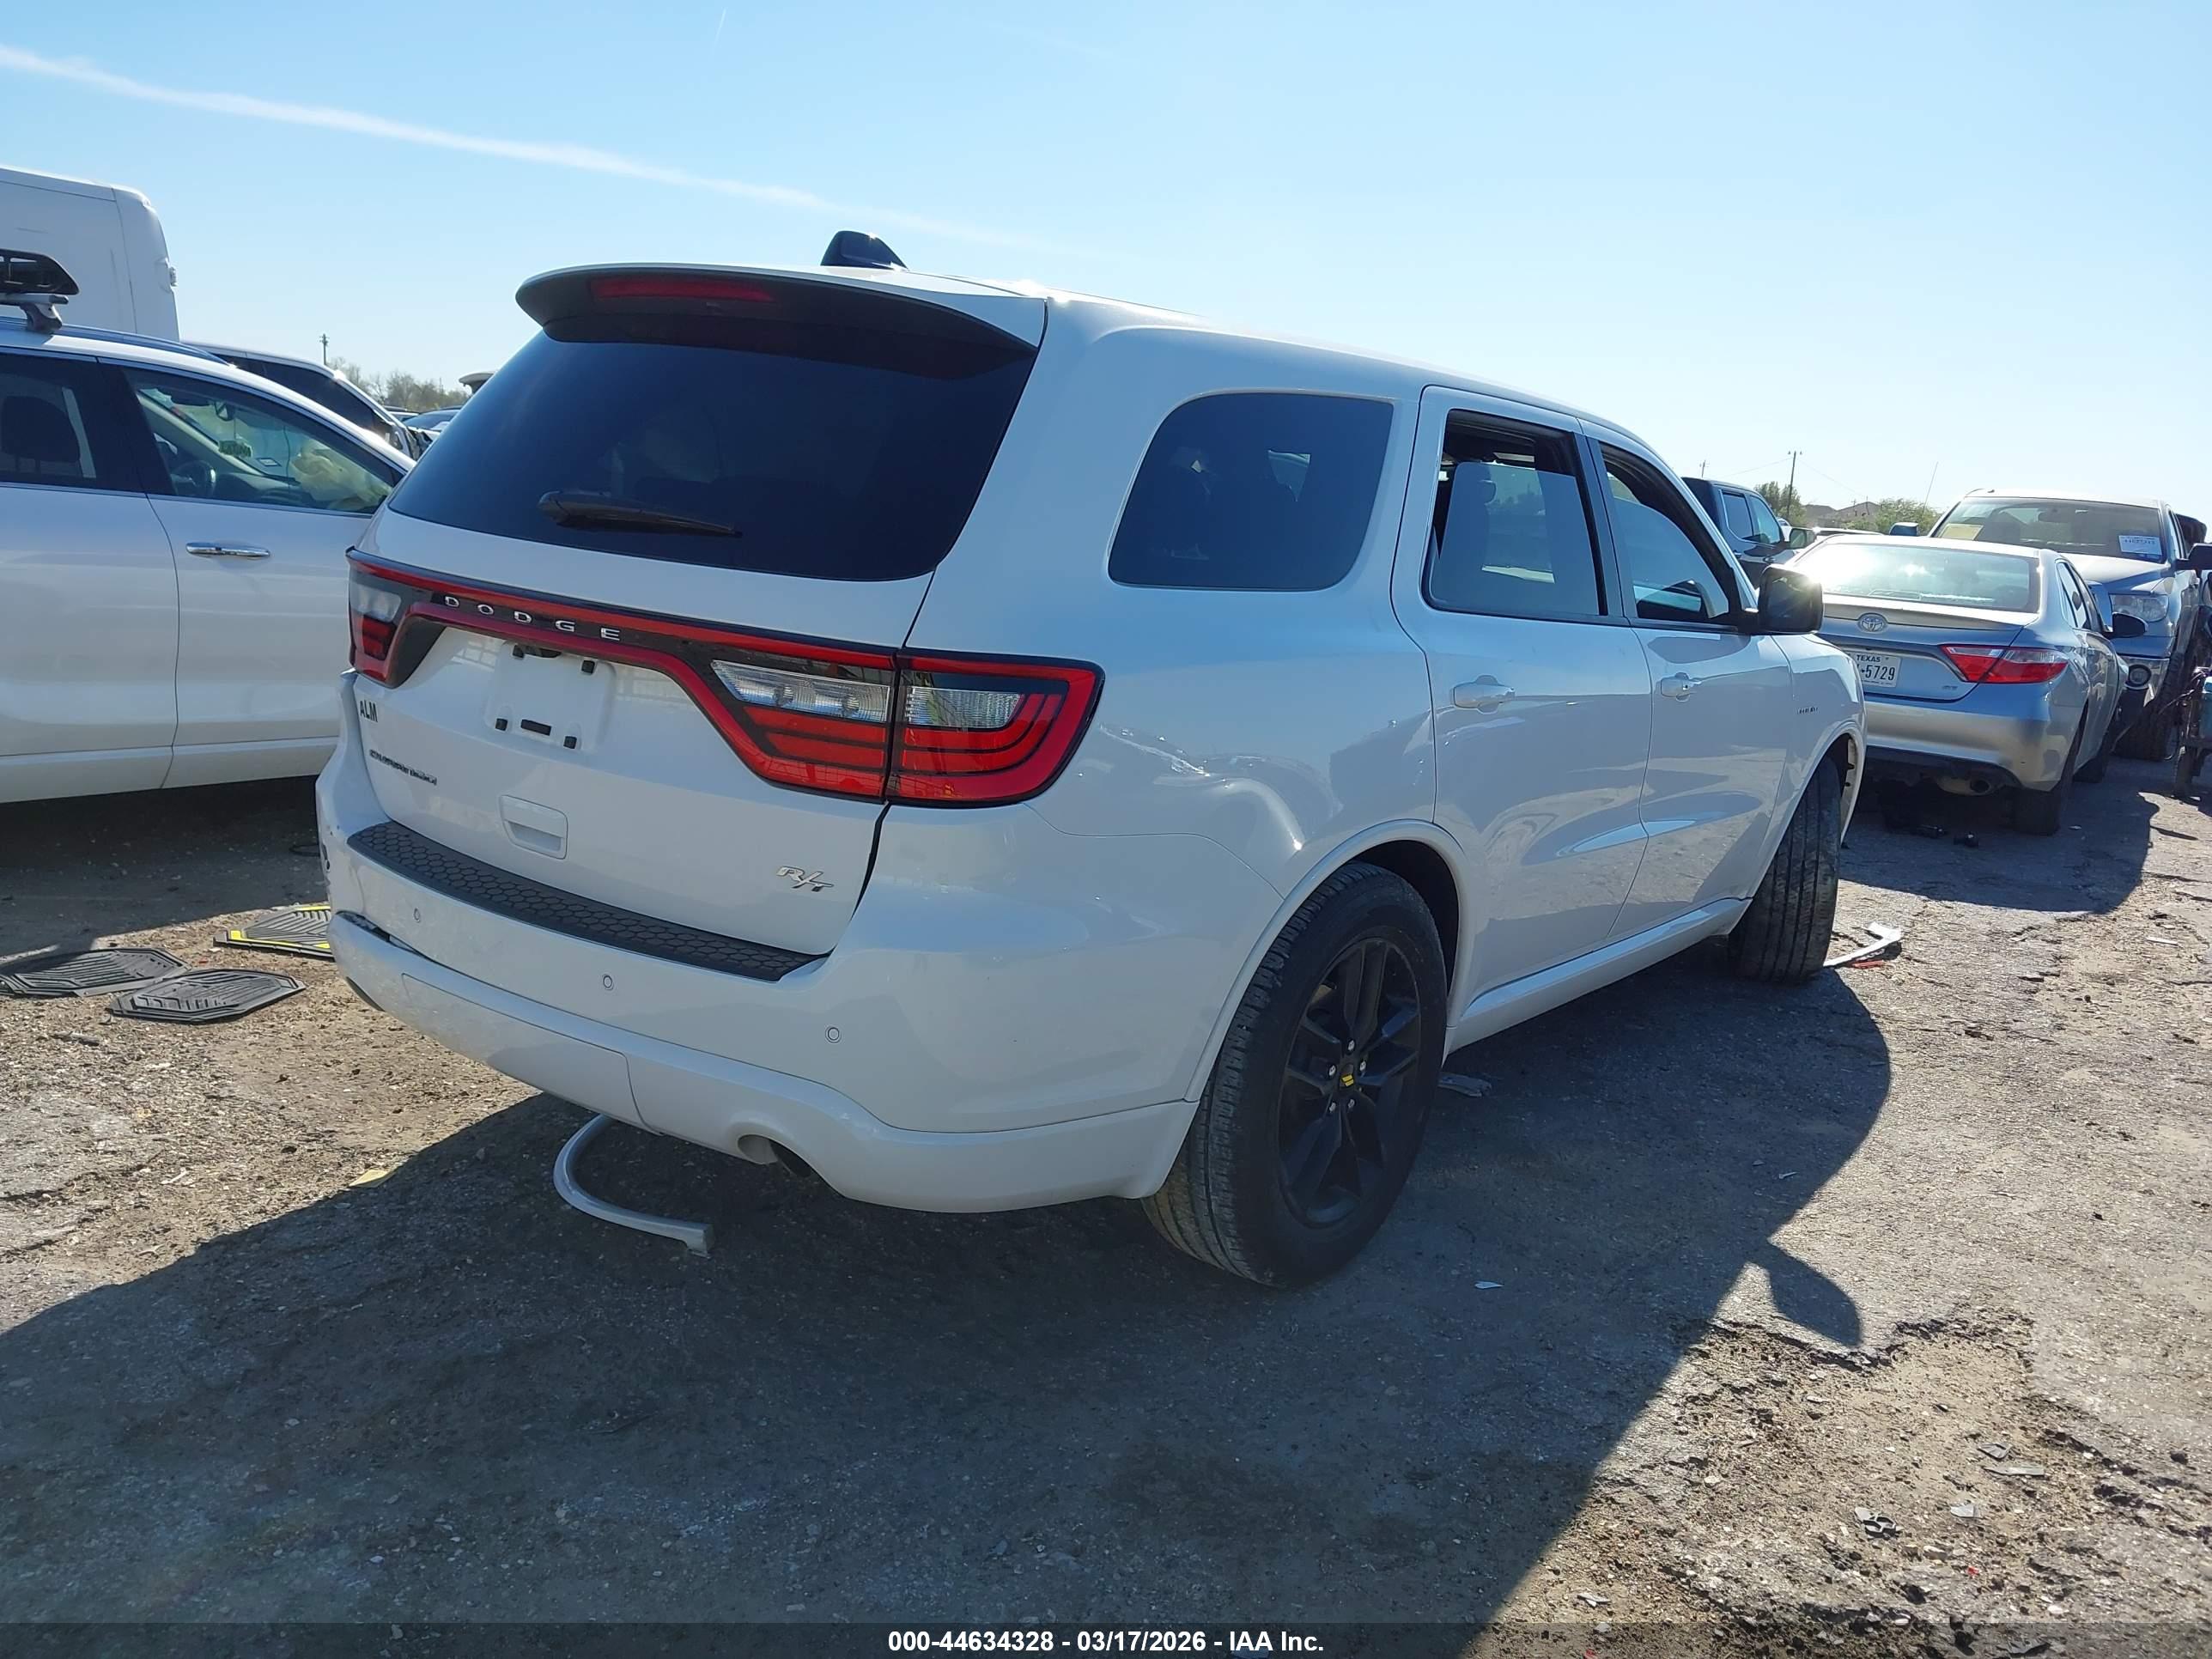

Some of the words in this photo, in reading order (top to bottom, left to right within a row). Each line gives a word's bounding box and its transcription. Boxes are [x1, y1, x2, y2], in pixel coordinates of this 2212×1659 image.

[445, 596, 620, 641] DODGE
[1857, 664, 1895, 681] 5729
[360, 700, 378, 722] ALM
[776, 866, 835, 892] R/T
